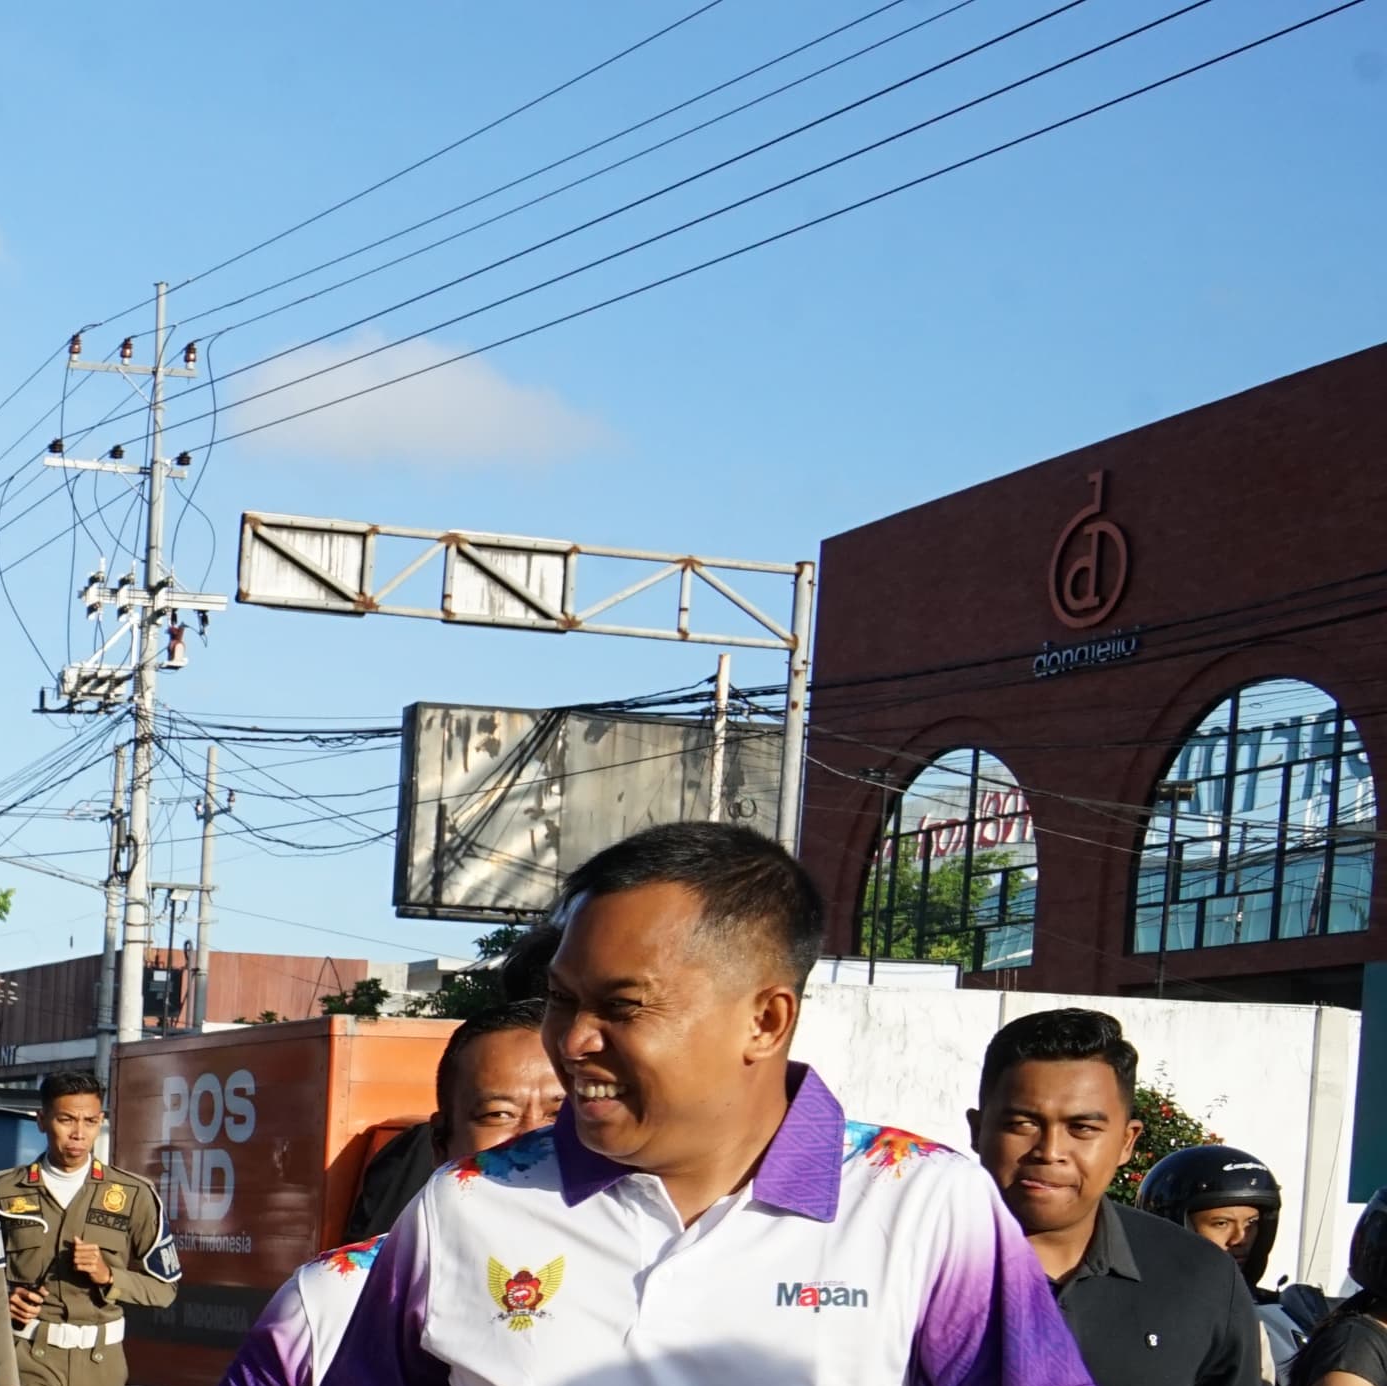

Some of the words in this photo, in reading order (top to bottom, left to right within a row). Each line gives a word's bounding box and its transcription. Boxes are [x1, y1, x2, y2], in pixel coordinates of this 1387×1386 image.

[161, 1069, 257, 1145] POS
[89, 1212, 111, 1227] POL
[113, 1217, 128, 1231] PP
[199, 1230, 252, 1254] Indonesia
[776, 1282, 868, 1313] Mapan
